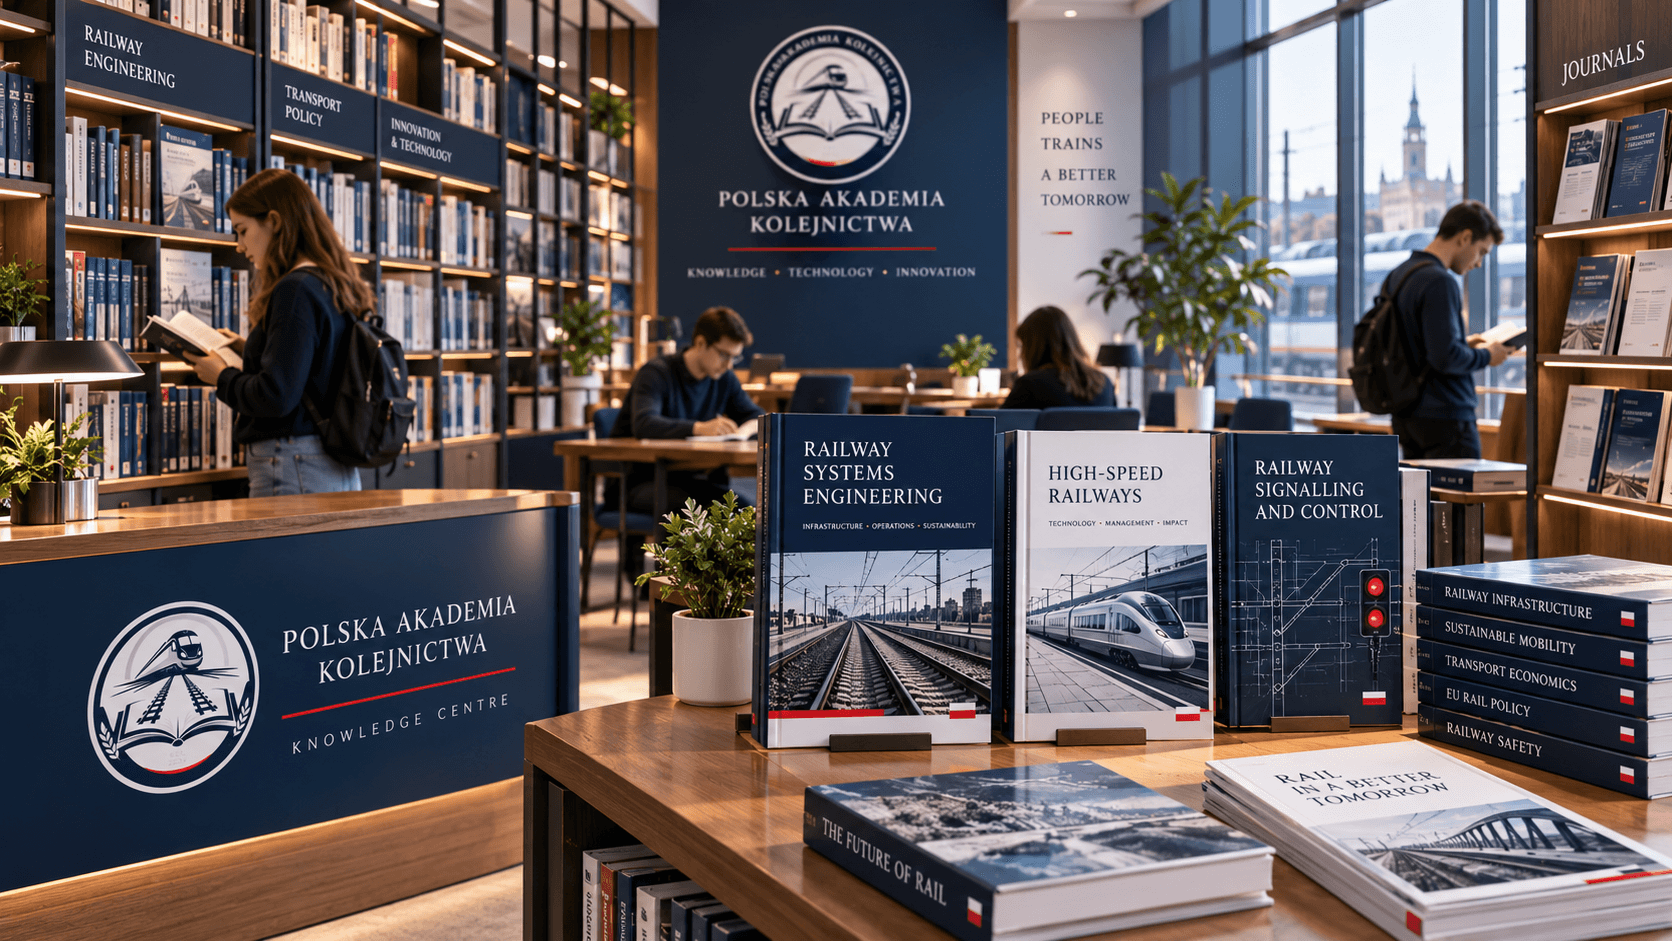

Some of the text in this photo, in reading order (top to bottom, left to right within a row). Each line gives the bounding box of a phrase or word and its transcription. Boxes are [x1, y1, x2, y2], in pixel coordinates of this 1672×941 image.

[84, 24, 143, 57] RAILWAY
[84, 49, 176, 89] ENGINEERING
[1561, 40, 1645, 87] JOURNALS
[285, 84, 342, 113] TRANSPORT
[285, 105, 323, 127] POLICY
[1041, 112, 1104, 124] PEOPLE
[391, 117, 441, 143] INNOVATION
[391, 136, 452, 163] & TECHNOLOGY
[1041, 137, 1103, 150] TRAINS
[1041, 168, 1117, 181] A BETTER
[718, 190, 945, 207] POLSKA AKADEMIA
[1040, 193, 1130, 206] TOMORROW
[750, 215, 914, 236] KOLEJNICTWA
[687, 267, 976, 278] KNOWLEDGE TECHNOLOGY INNOVATION
[804, 441, 893, 457] RAILWAY
[803, 464, 895, 481] SYSTEMS
[1048, 465, 1163, 481] HIGH-SPEED
[1255, 460, 1334, 476] RAILWAY
[803, 488, 943, 505] ENGINEERING
[1048, 488, 1142, 503] RAILWAYS
[1255, 482, 1365, 498] SIGNALLING
[1255, 503, 1384, 520] AND CONTROL
[802, 522, 864, 530] INFRASTRUCTURE
[871, 522, 915, 530] OPERATIONS
[1445, 586, 1489, 603] RAILWAY
[1492, 593, 1593, 620] INFRASTRUCTURE
[282, 594, 517, 654] POLSKA AKADEMIA
[1445, 621, 1515, 644] SUSTAINABLE
[1519, 634, 1576, 655] MOBILITY
[319, 633, 487, 684] KOLEJNICTWA
[1445, 655, 1577, 692] TRANSPORT ECONOMICS
[1446, 687, 1531, 718] EU RAIL POLICY
[292, 693, 509, 755] KNOWLEDGE CENTRE
[1446, 721, 1543, 757] RAILWAY SAFETY
[1273, 769, 1343, 784] RAIL
[1291, 771, 1441, 795] IN A BETTER
[1306, 782, 1449, 807] TOMORROW
[822, 817, 844, 845] THE
[846, 831, 891, 873] FUTURE
[894, 860, 912, 884] OF
[915, 870, 947, 907] RAIL
